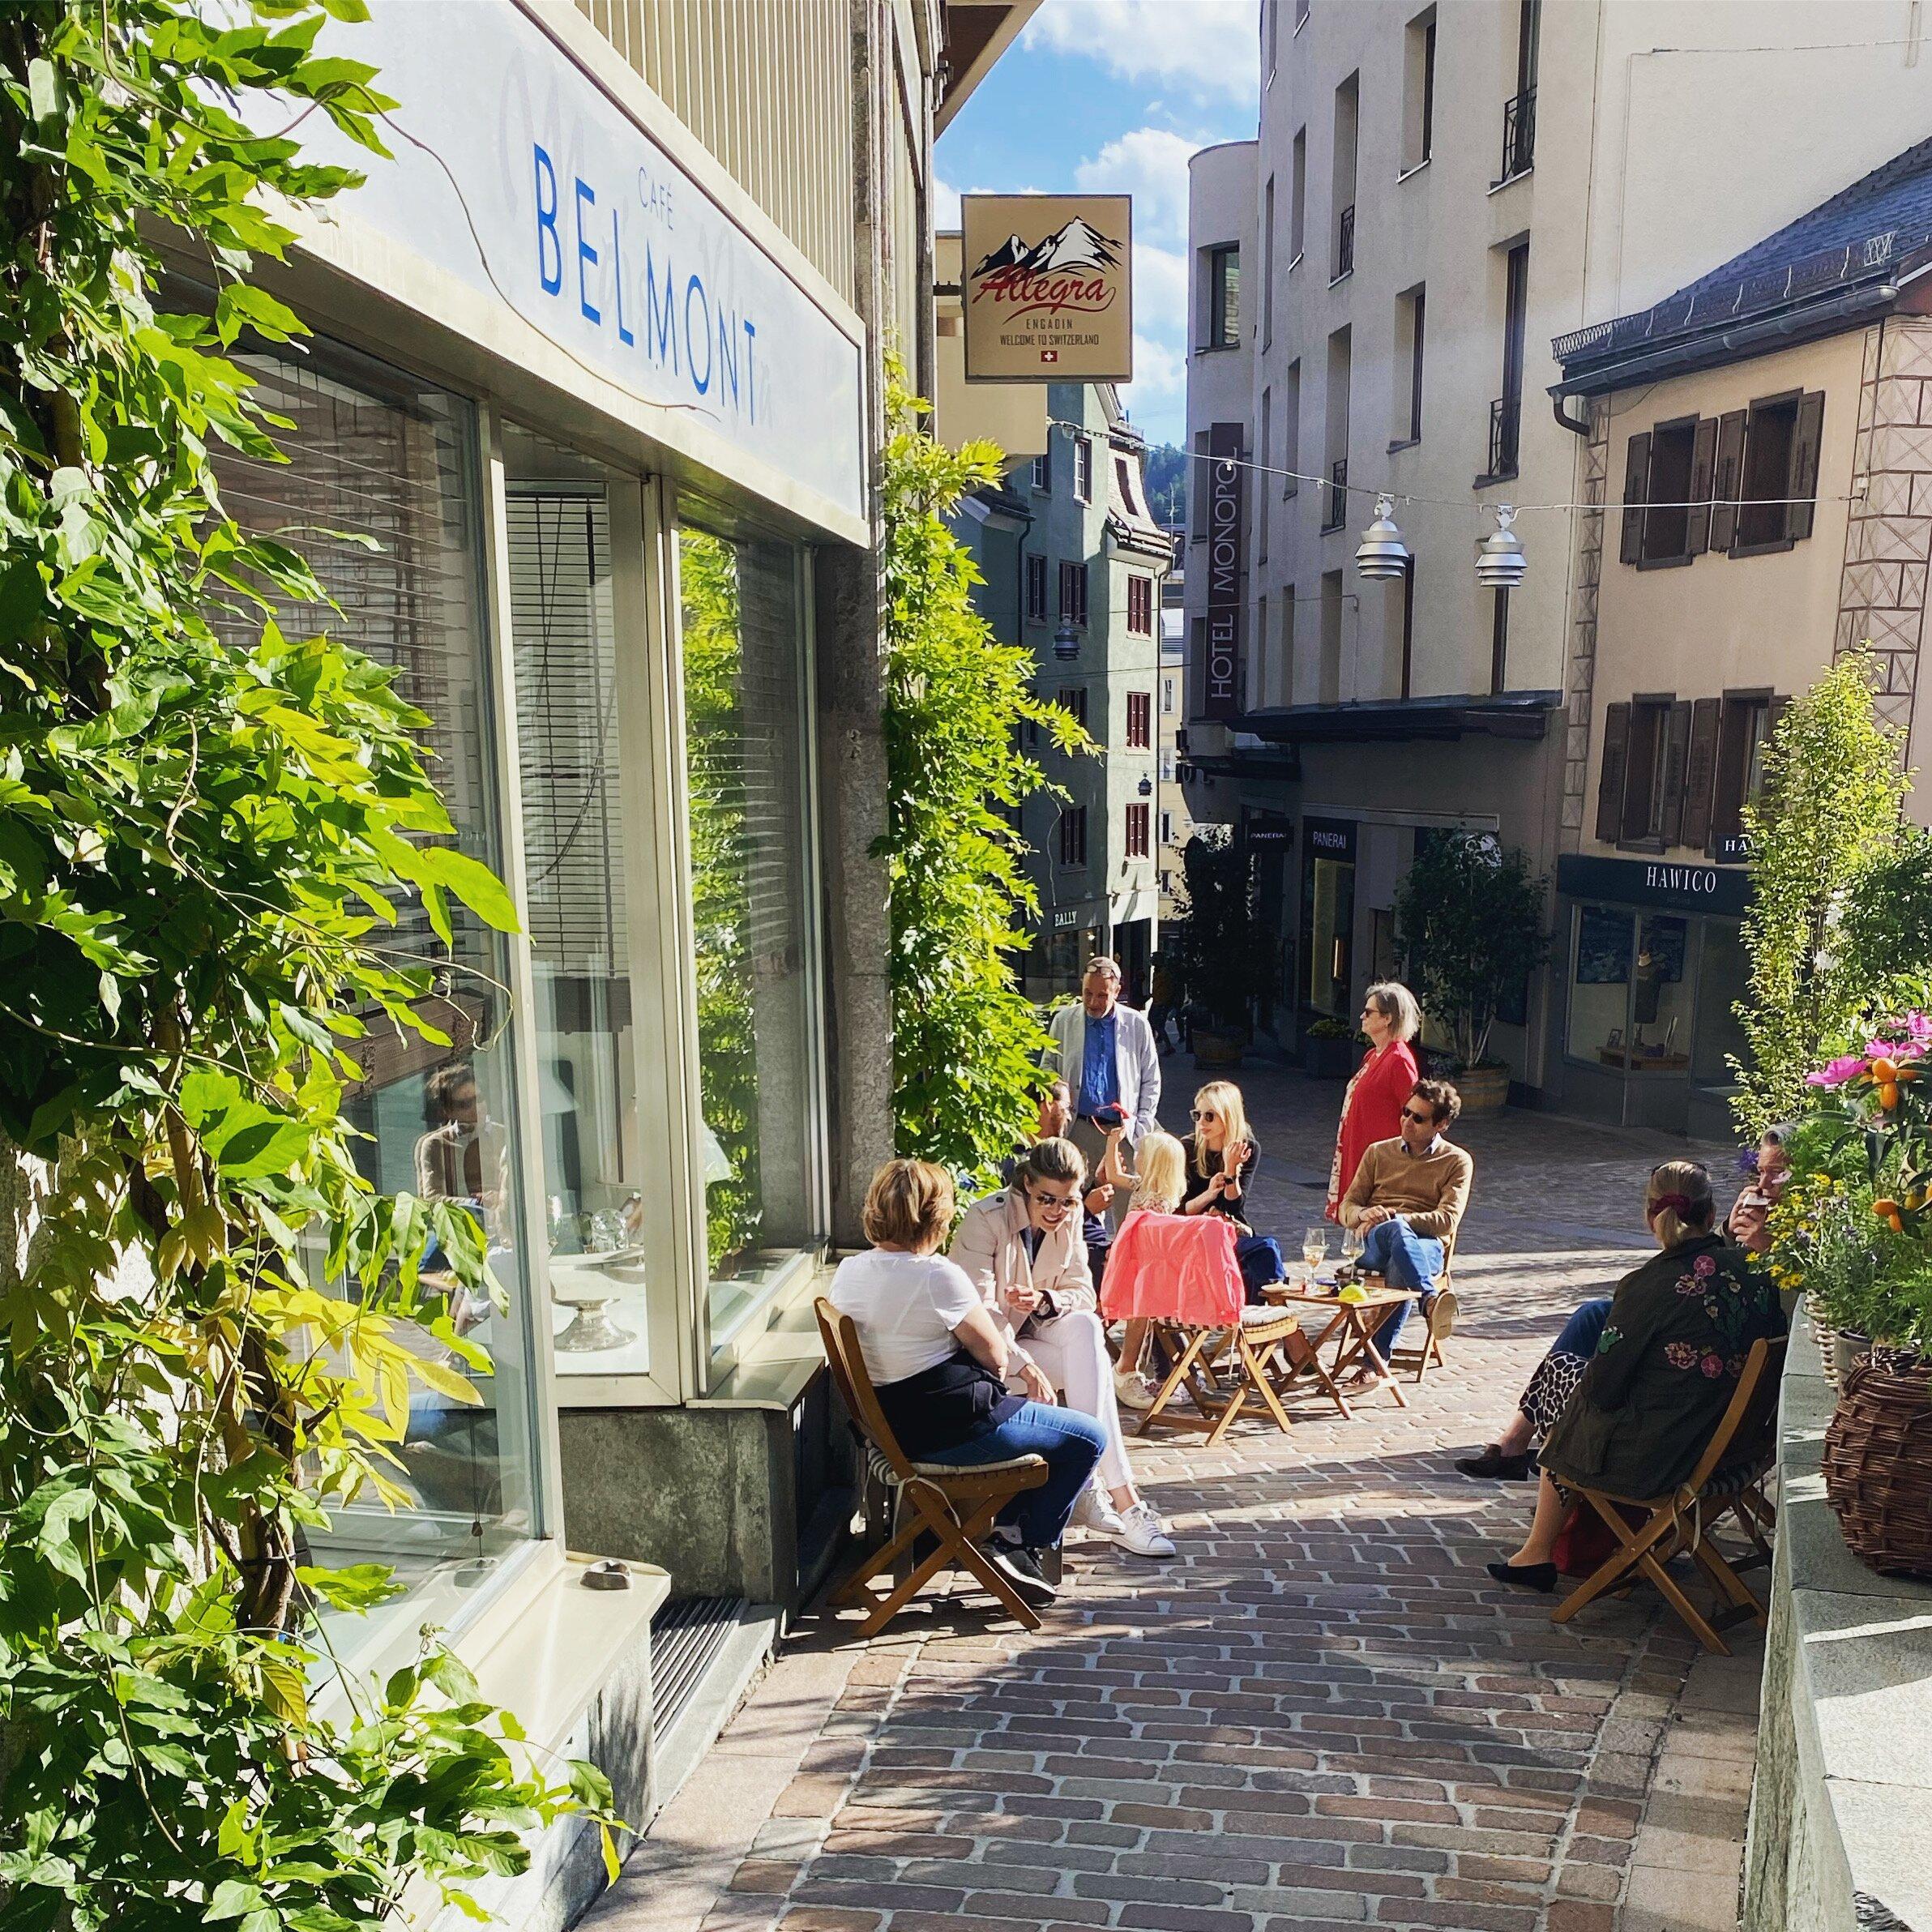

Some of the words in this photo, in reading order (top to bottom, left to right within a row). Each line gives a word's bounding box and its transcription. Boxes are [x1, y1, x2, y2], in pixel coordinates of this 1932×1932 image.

[637, 165, 674, 231] CAFÉ
[533, 142, 756, 426] BELMONT
[972, 263, 1117, 325] Allegra
[1026, 318, 1073, 330] ENGADIN
[1000, 334, 1035, 346] WELCOME
[1038, 334, 1047, 346] TO
[1049, 334, 1100, 346] SWITZERLAND
[1213, 447, 1238, 593] MONOPOL
[1211, 613, 1233, 699] HOTEL
[1250, 831, 1287, 840] PANERAI
[1313, 831, 1347, 849] PANERAI
[1646, 866, 1716, 893] HAWICO
[1054, 910, 1078, 927] BALLY
